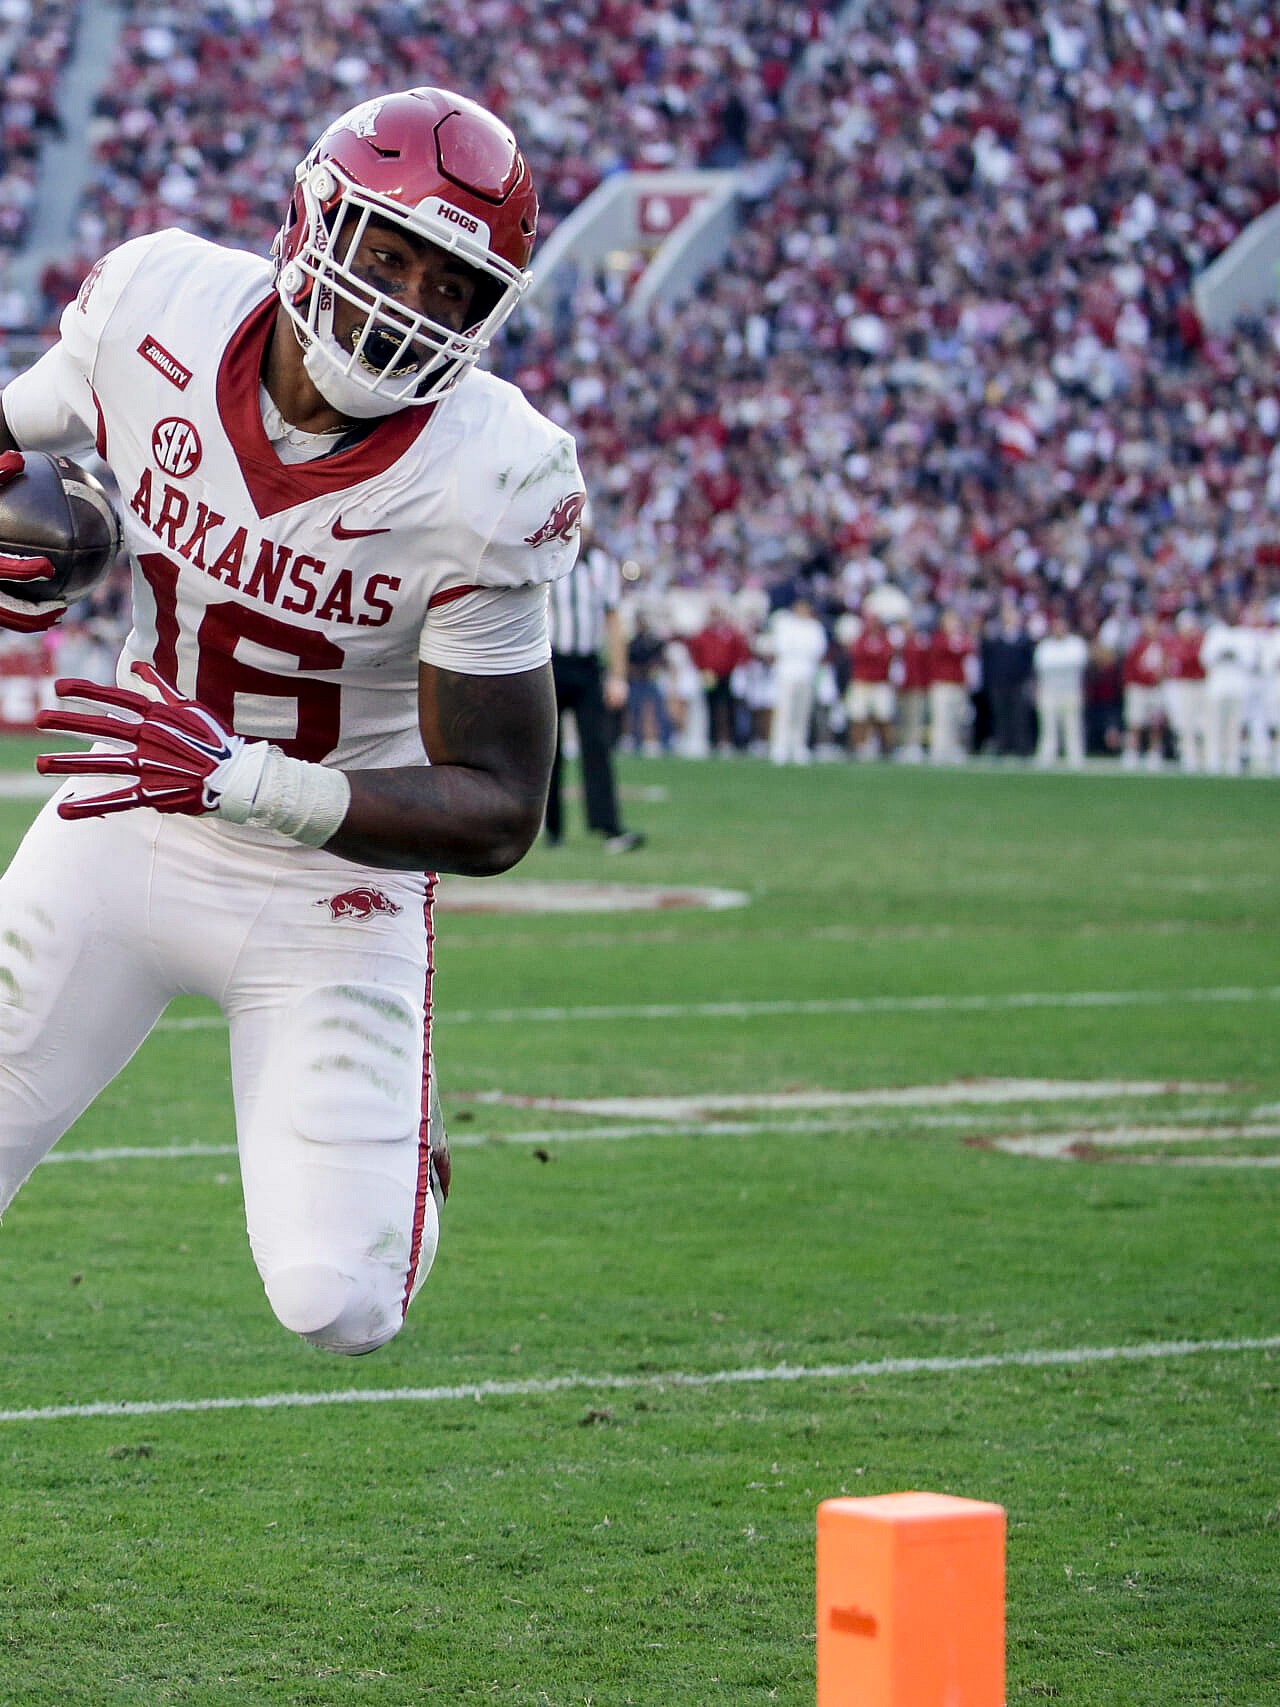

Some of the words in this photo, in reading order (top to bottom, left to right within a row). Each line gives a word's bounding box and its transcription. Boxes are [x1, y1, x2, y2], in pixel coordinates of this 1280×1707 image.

[437, 203, 479, 235] HOGS
[144, 345, 188, 384] EQUALITY
[153, 419, 200, 477] SEC
[130, 466, 402, 628] ARKANSAS
[135, 552, 346, 764] 16
